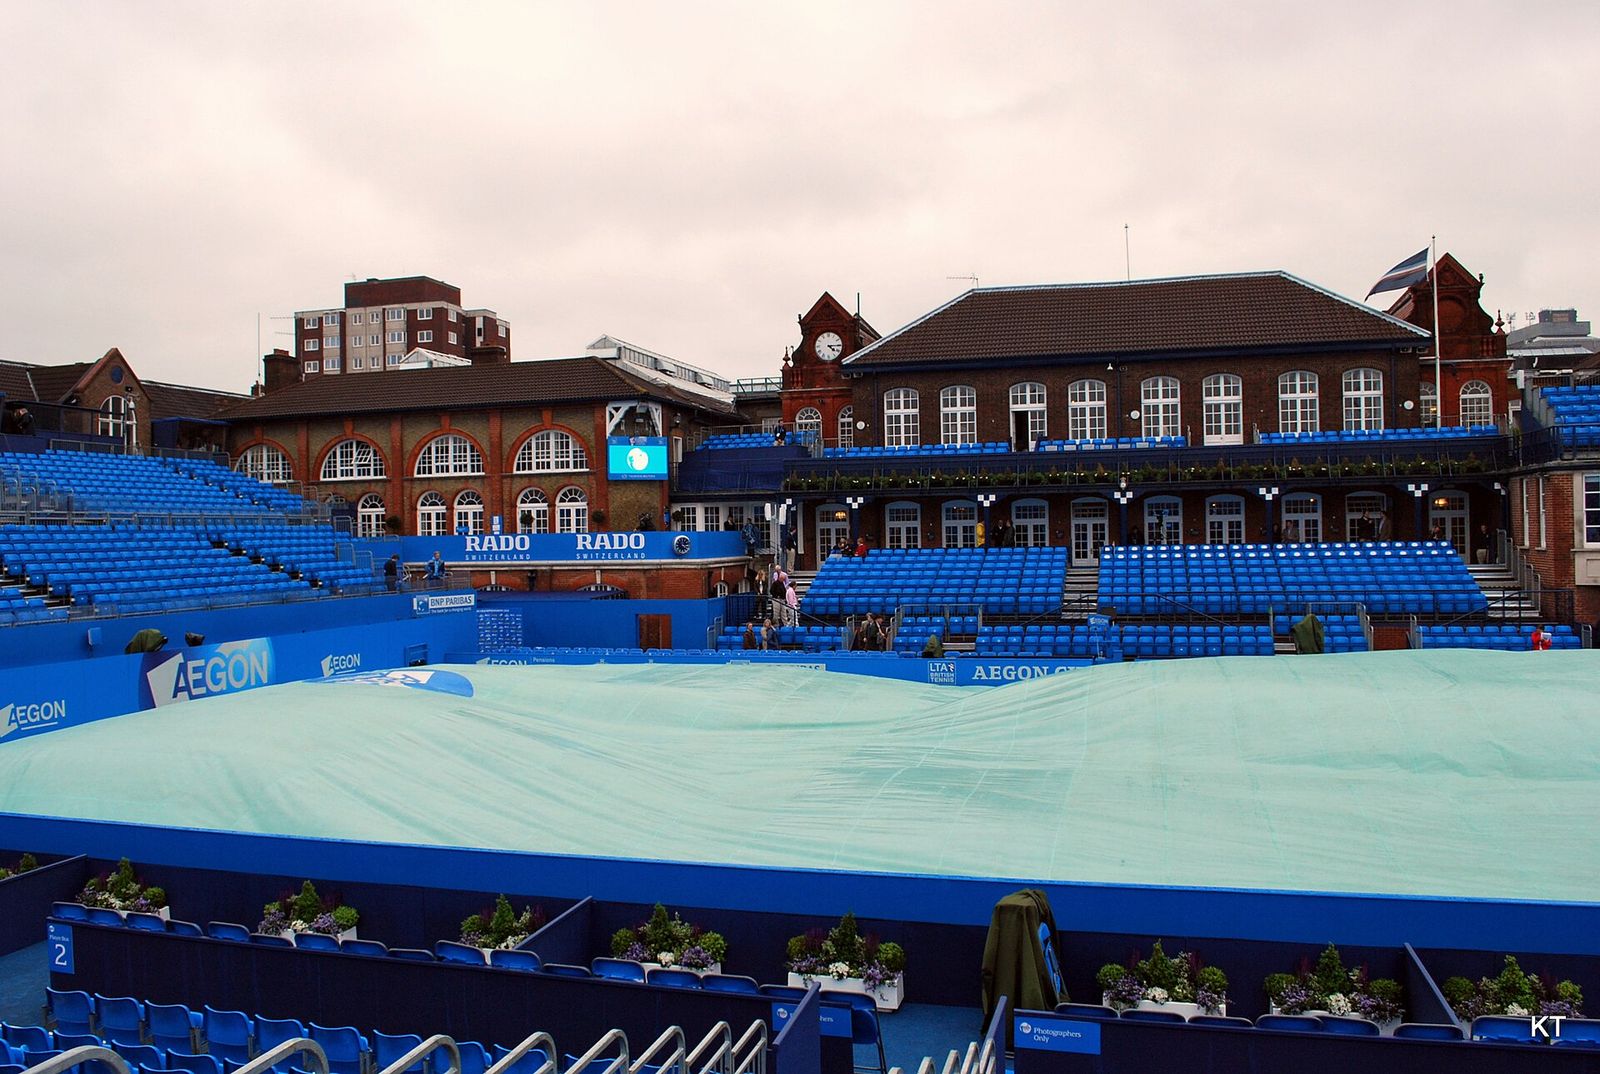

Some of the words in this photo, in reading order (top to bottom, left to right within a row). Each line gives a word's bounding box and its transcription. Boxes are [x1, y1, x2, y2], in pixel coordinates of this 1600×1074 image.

[465, 535, 530, 551] RADO
[576, 533, 645, 550] RADO
[430, 598, 445, 607] BNP
[445, 595, 473, 605] PARIBAS
[328, 653, 361, 671] AEGON
[929, 662, 950, 672] LTA
[172, 650, 269, 700] AEGON
[972, 665, 1048, 681] AEGON
[7, 699, 66, 727] AEGON
[55, 943, 67, 966] 2
[1033, 1027, 1082, 1039] Photographers
[1033, 1034, 1050, 1044] Only
